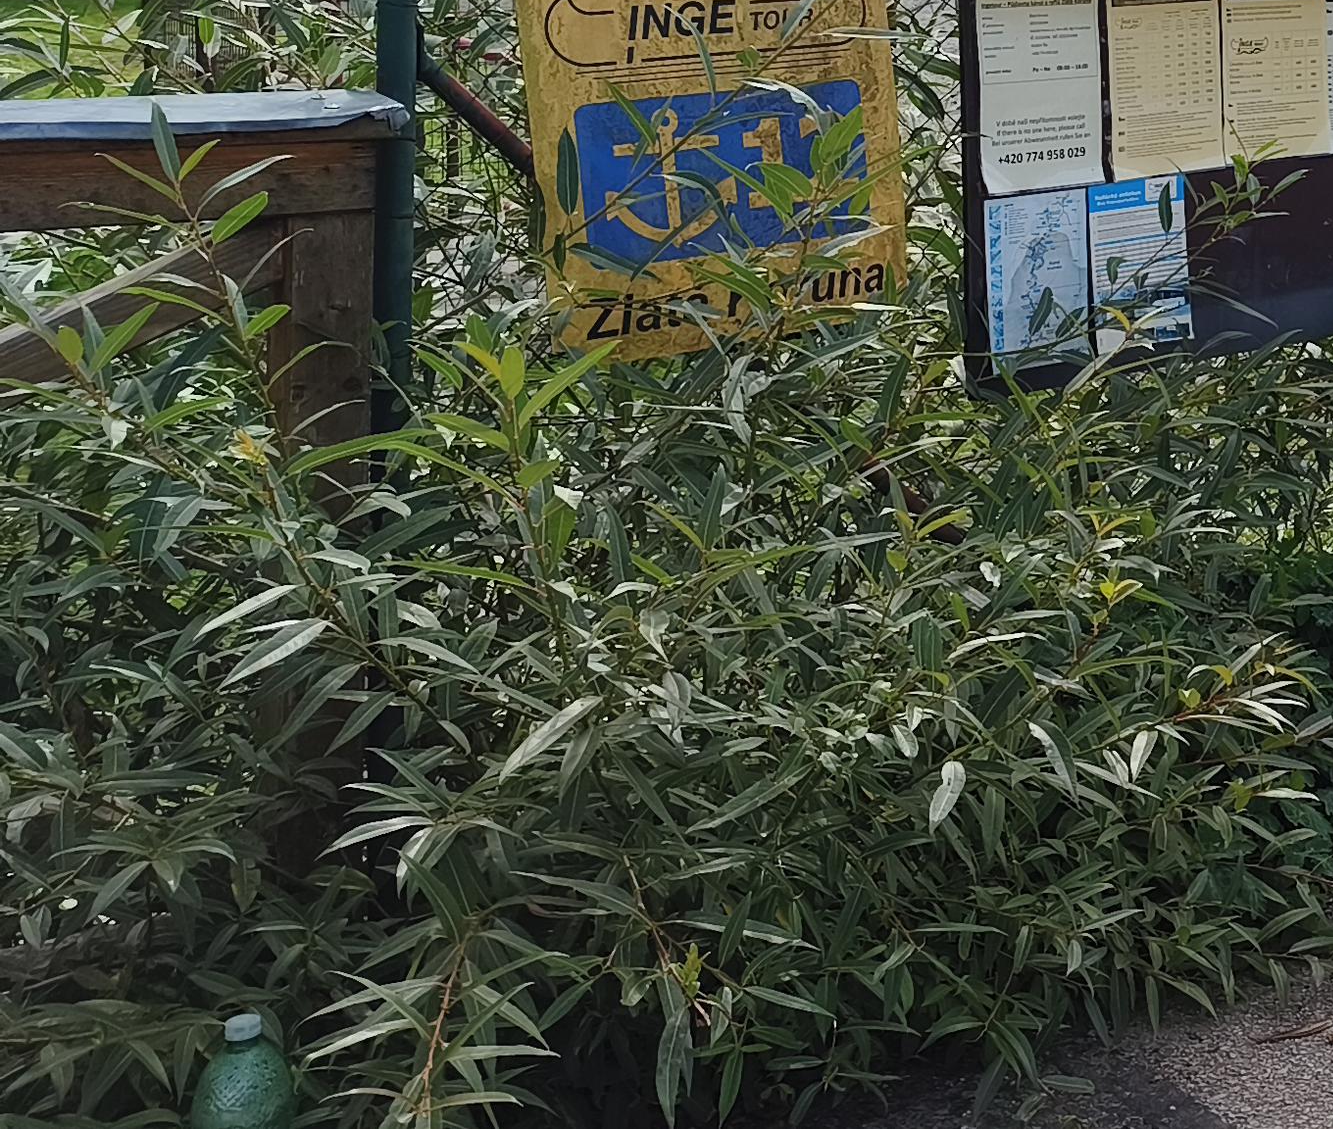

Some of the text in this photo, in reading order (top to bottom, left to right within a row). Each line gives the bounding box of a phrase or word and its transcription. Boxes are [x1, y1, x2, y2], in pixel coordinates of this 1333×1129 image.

[743, 111, 862, 209] 1
[998, 146, 1086, 165] +420 774 958 029
[728, 262, 885, 318] una
